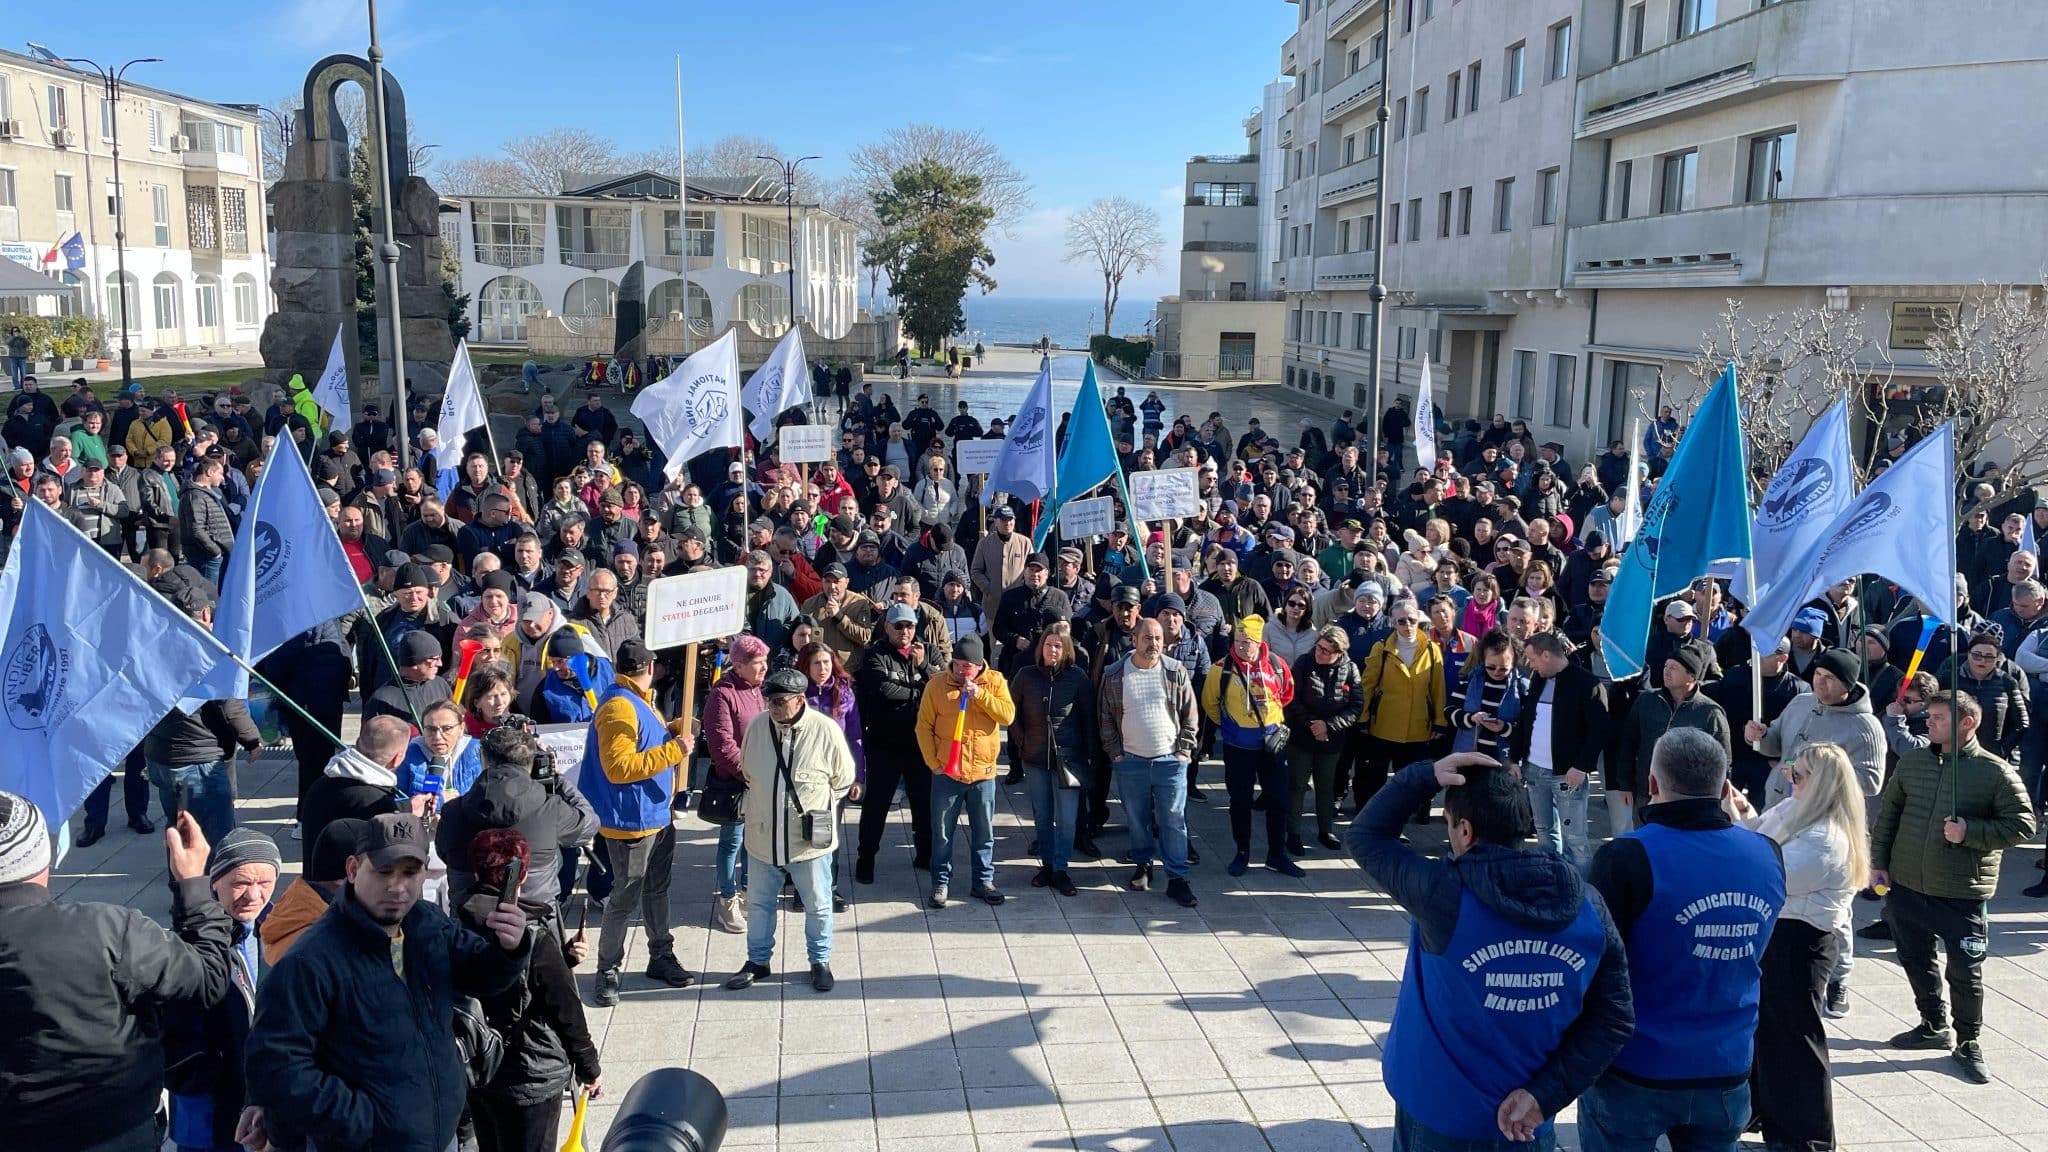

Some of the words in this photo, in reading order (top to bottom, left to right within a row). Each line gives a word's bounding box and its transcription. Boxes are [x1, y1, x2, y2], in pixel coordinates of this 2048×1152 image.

[676, 600, 687, 608] NE
[688, 594, 722, 606] CHINUIE
[661, 611, 691, 623] STATUL
[693, 604, 729, 617] DEGEABA
[19, 645, 41, 686] LIBER
[59, 647, 69, 673] 1997
[1675, 891, 1747, 925] SINDICATUL
[1747, 894, 1774, 921] LIBER
[1694, 922, 1760, 938] NAVALISTUL
[1462, 939, 1548, 973] SINDICATUL
[1548, 943, 1587, 972] LIBER
[1485, 972, 1565, 988] NAVALISTUL
[1484, 991, 1560, 1013] MANGALIA
